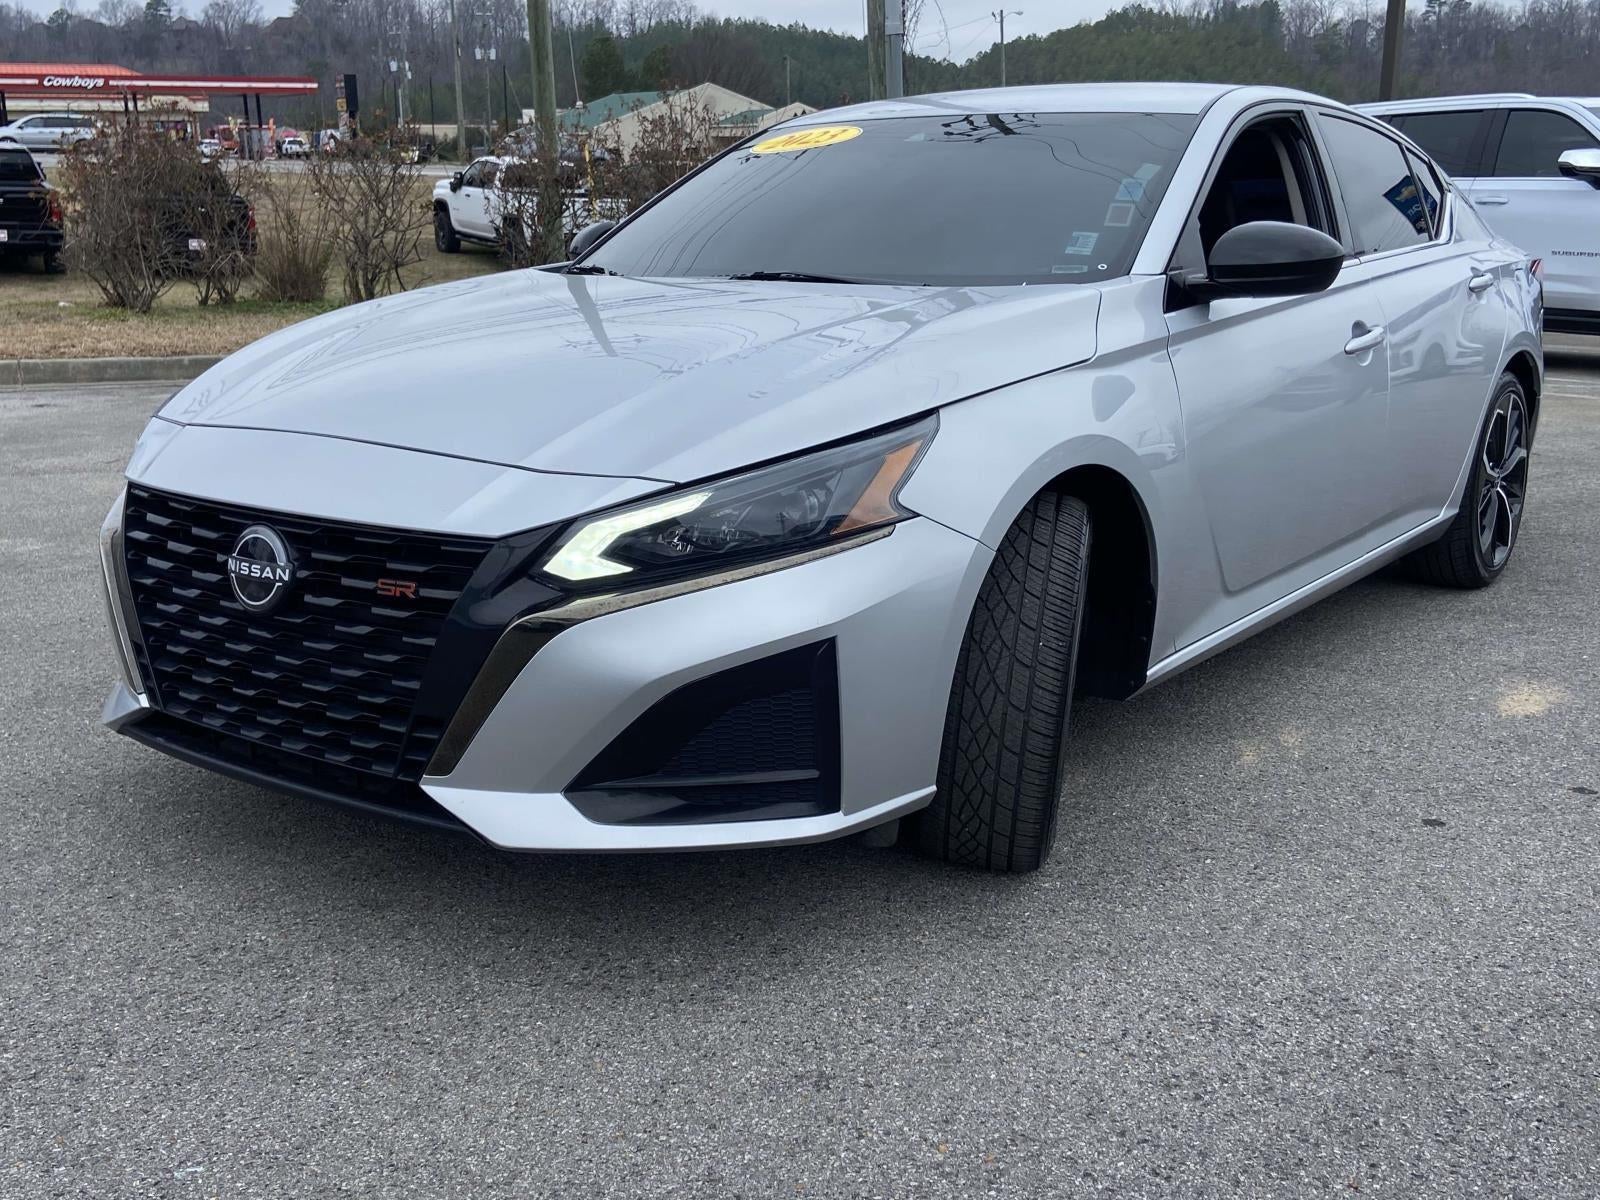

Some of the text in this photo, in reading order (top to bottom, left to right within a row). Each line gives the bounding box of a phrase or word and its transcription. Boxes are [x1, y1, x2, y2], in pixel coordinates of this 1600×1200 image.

[43, 75, 105, 90] Cowboys
[228, 557, 290, 582] NISSAN
[376, 578, 416, 599] SR
